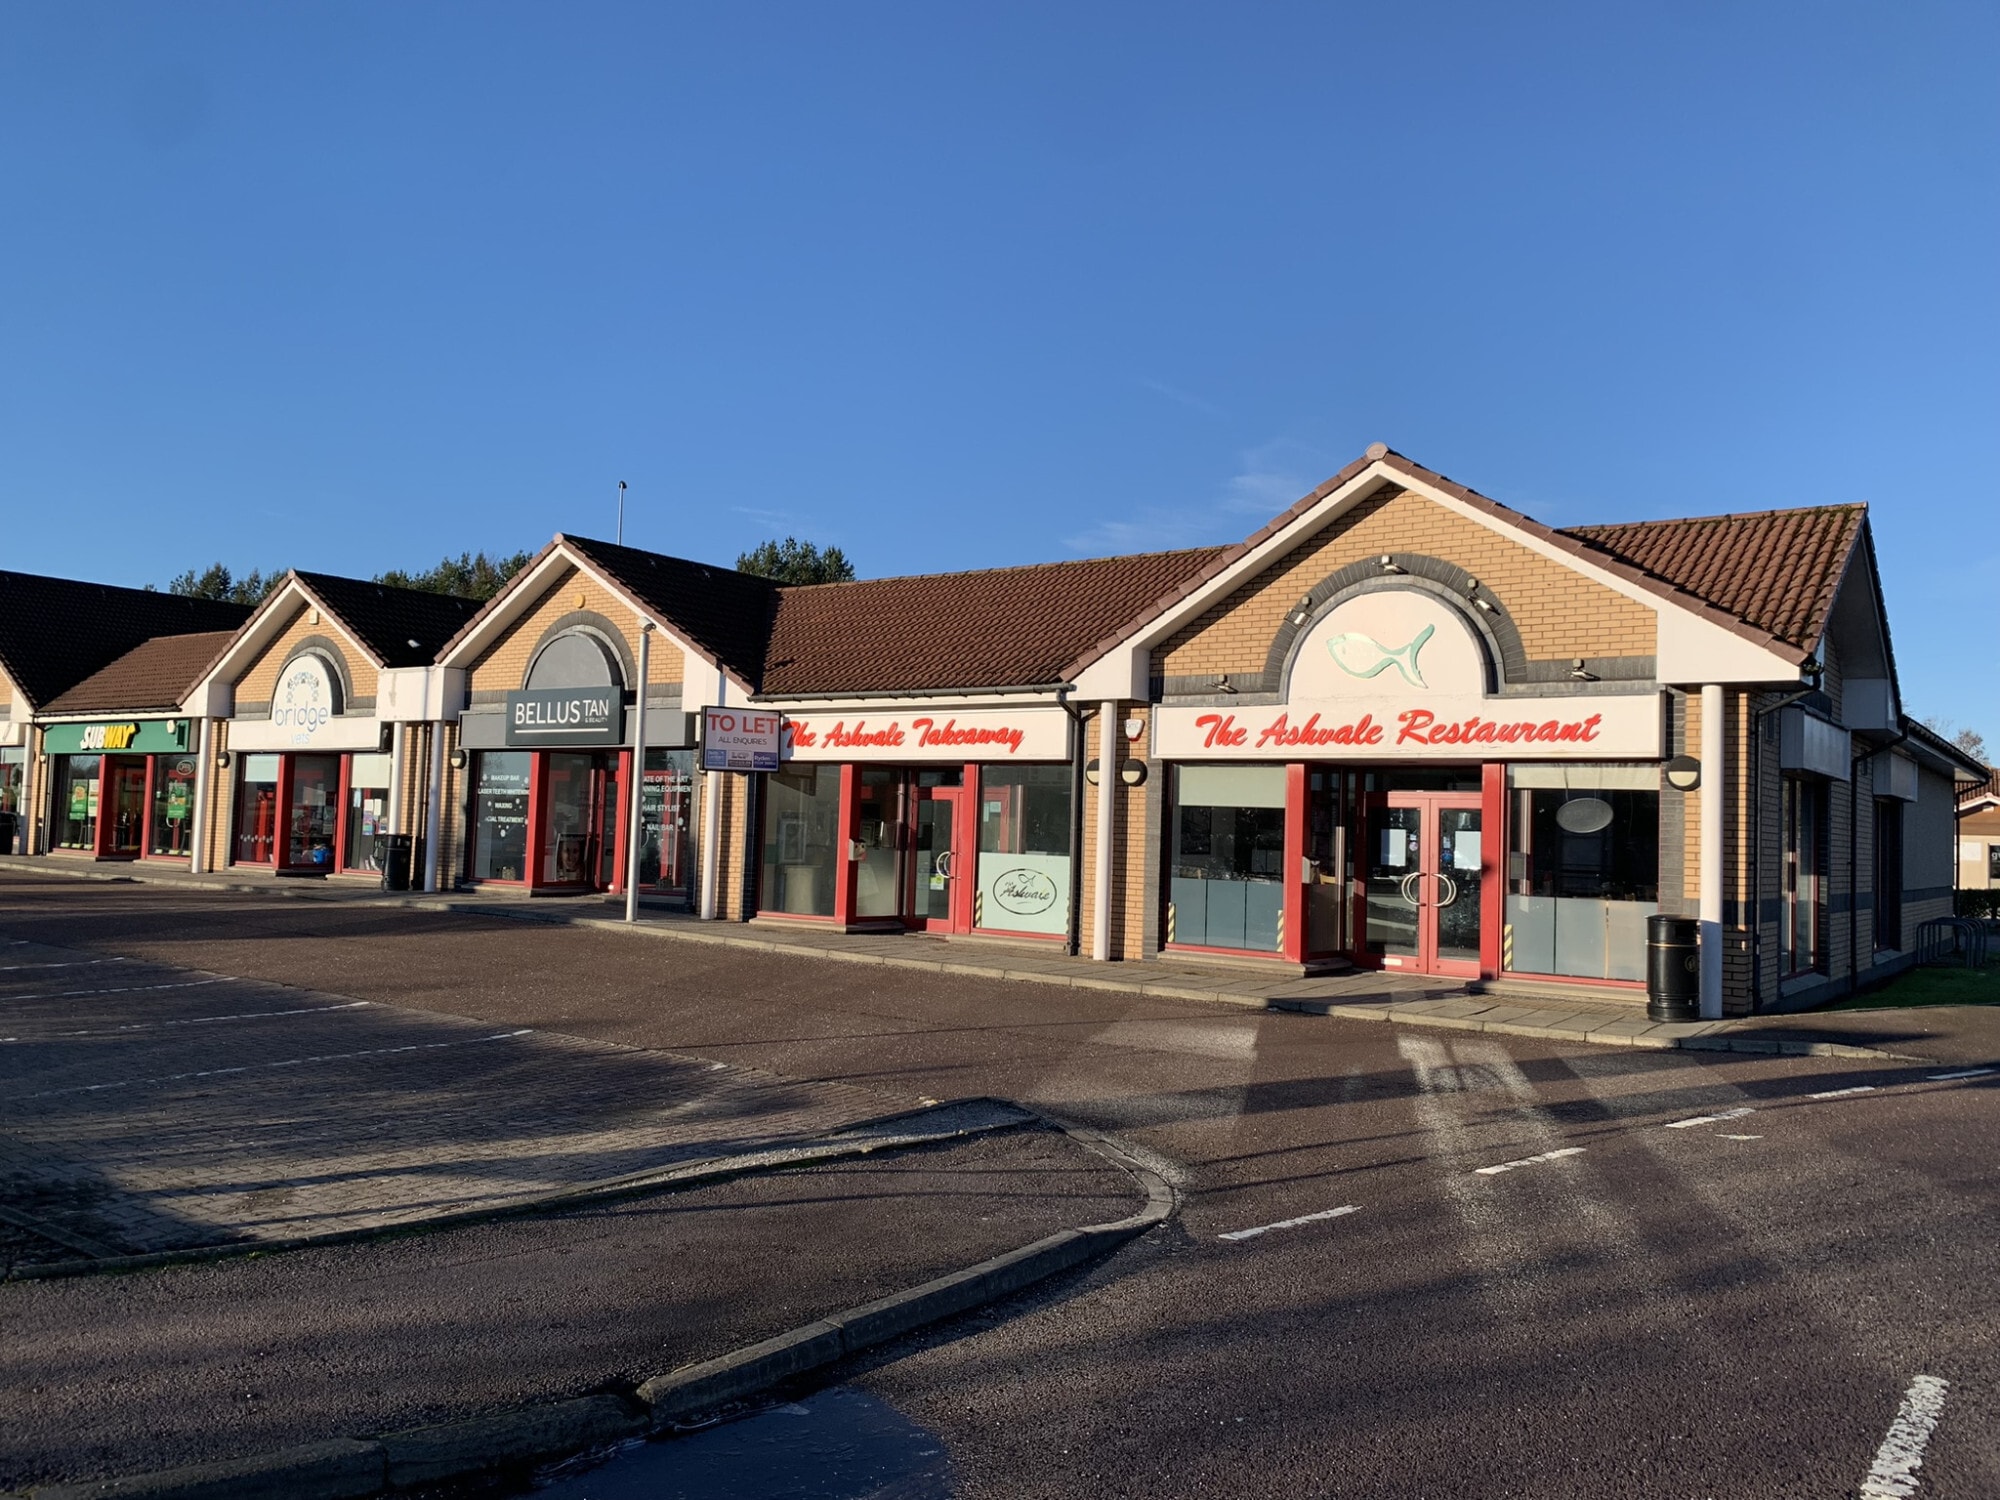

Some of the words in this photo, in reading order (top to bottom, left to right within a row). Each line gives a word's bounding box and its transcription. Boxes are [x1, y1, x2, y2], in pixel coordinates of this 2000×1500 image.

[274, 700, 328, 732] bridge
[515, 700, 580, 724] BELLUS
[582, 699, 609, 716] TAN
[708, 714, 735, 732] TO
[743, 716, 778, 734] LET
[80, 722, 138, 749] SUBWAY
[291, 733, 310, 744] vets
[718, 736, 731, 744] ALL
[733, 737, 767, 745] ENQUIRIES
[782, 720, 816, 749] The
[821, 720, 904, 749] Ashvale
[912, 717, 1024, 753] Takeaway
[1195, 713, 1247, 748] The
[1255, 712, 1384, 748] Ashvale
[1396, 709, 1602, 745] Restaurant
